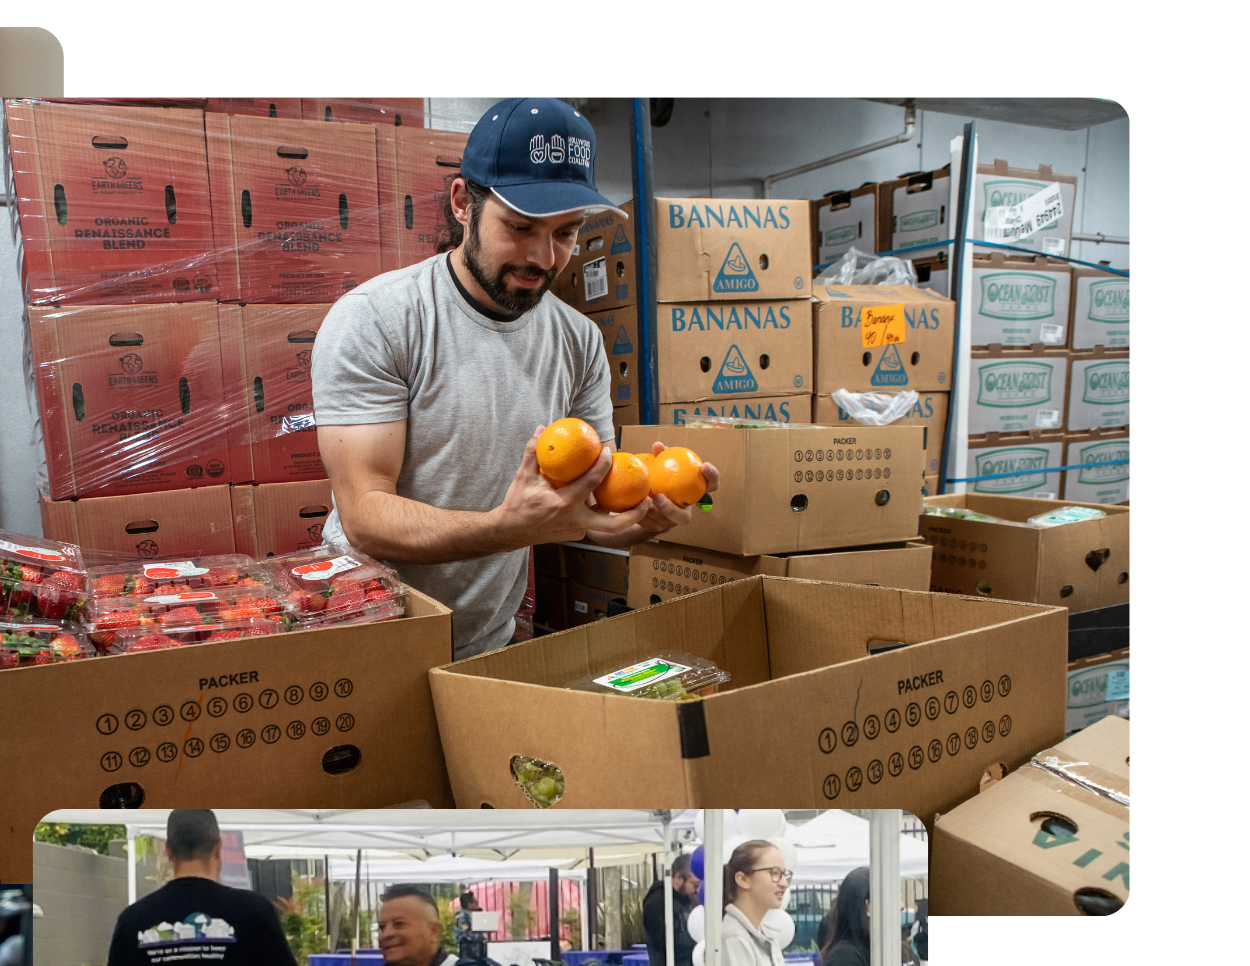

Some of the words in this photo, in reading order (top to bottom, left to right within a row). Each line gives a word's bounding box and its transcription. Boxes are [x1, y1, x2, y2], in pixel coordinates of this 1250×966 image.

[568, 136, 590, 148] HOLLYWOOD
[568, 143, 591, 161] FOOD
[568, 156, 590, 169] COALITION
[92, 181, 115, 190] EARTH
[116, 181, 143, 190] GREENS
[275, 188, 296, 196] EARTH
[297, 188, 320, 197] GREENS
[94, 217, 149, 226] ORGANIC
[668, 204, 790, 230] BANANAS
[276, 221, 323, 230] ORGANIC
[74, 228, 170, 239] RENAISSANCE
[258, 232, 342, 242] RENAISSANCE
[103, 239, 146, 250] BLEND
[282, 242, 320, 252] BLEND
[716, 278, 756, 290] AMIGO
[987, 282, 1021, 302] OCEAN
[671, 305, 791, 332] BANANAS
[841, 306, 940, 330] BNAS
[109, 376, 131, 386] EARTH
[132, 375, 158, 384] GREENS
[716, 378, 755, 392] AMIGO
[874, 375, 906, 384] AMIGO
[985, 372, 1019, 392] OCEAN
[288, 404, 314, 412] ORGA
[111, 409, 164, 420] ORGANIC
[683, 556, 703, 566] PACKER
[199, 670, 260, 690] PACKER
[898, 670, 944, 695] PACKER
